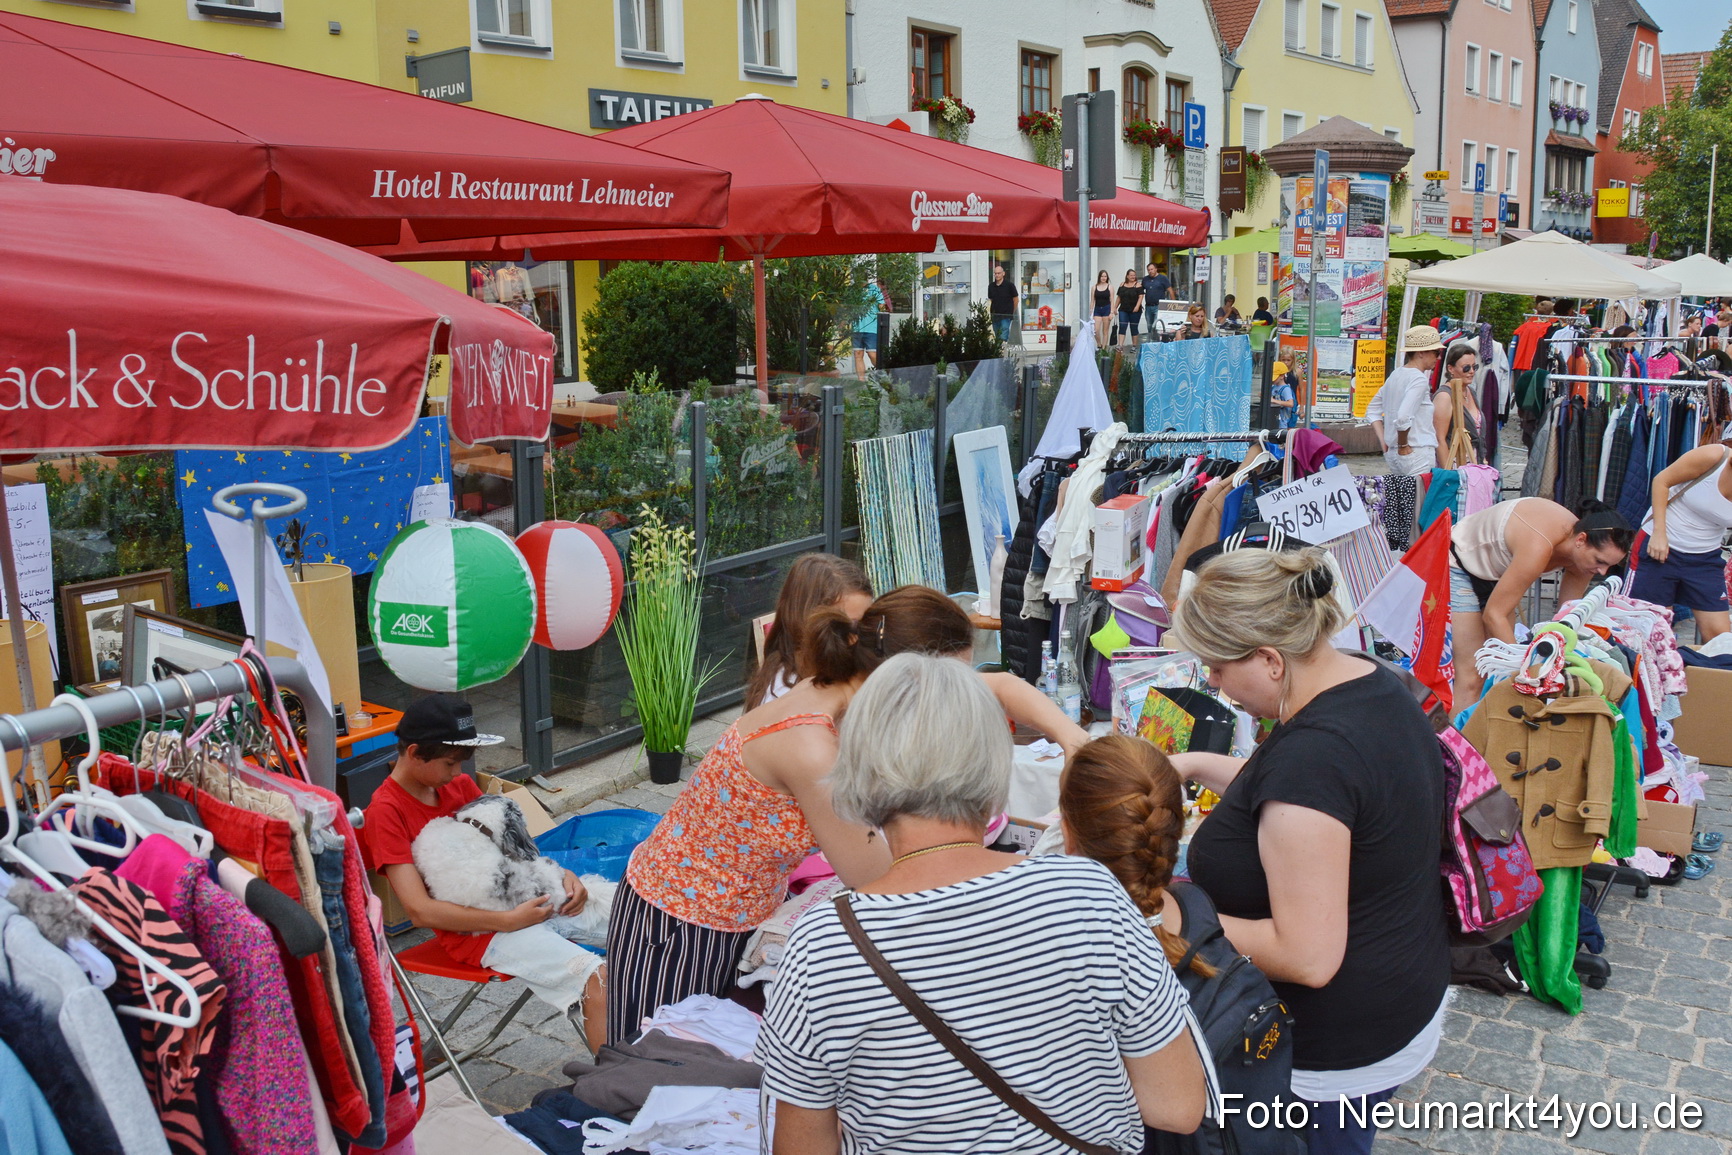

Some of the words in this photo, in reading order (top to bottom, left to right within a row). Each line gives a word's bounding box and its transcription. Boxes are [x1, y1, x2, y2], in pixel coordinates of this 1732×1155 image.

[421, 82, 465, 99] TAIFUN
[1189, 108, 1201, 142] P
[370, 169, 442, 199] Hotel
[448, 171, 574, 203] Restaurant
[579, 178, 675, 208] Lehmeier
[1317, 158, 1326, 205] P
[1476, 166, 1484, 189] P
[911, 190, 993, 232] Glossner-Bier
[1500, 196, 1506, 218] P
[1110, 213, 1152, 233] Restaurant
[1153, 217, 1187, 236] Lehmeier
[112, 353, 157, 408] &
[169, 331, 387, 417] Schühle
[1269, 483, 1304, 505] DAMEN
[392, 613, 434, 633] AOK
